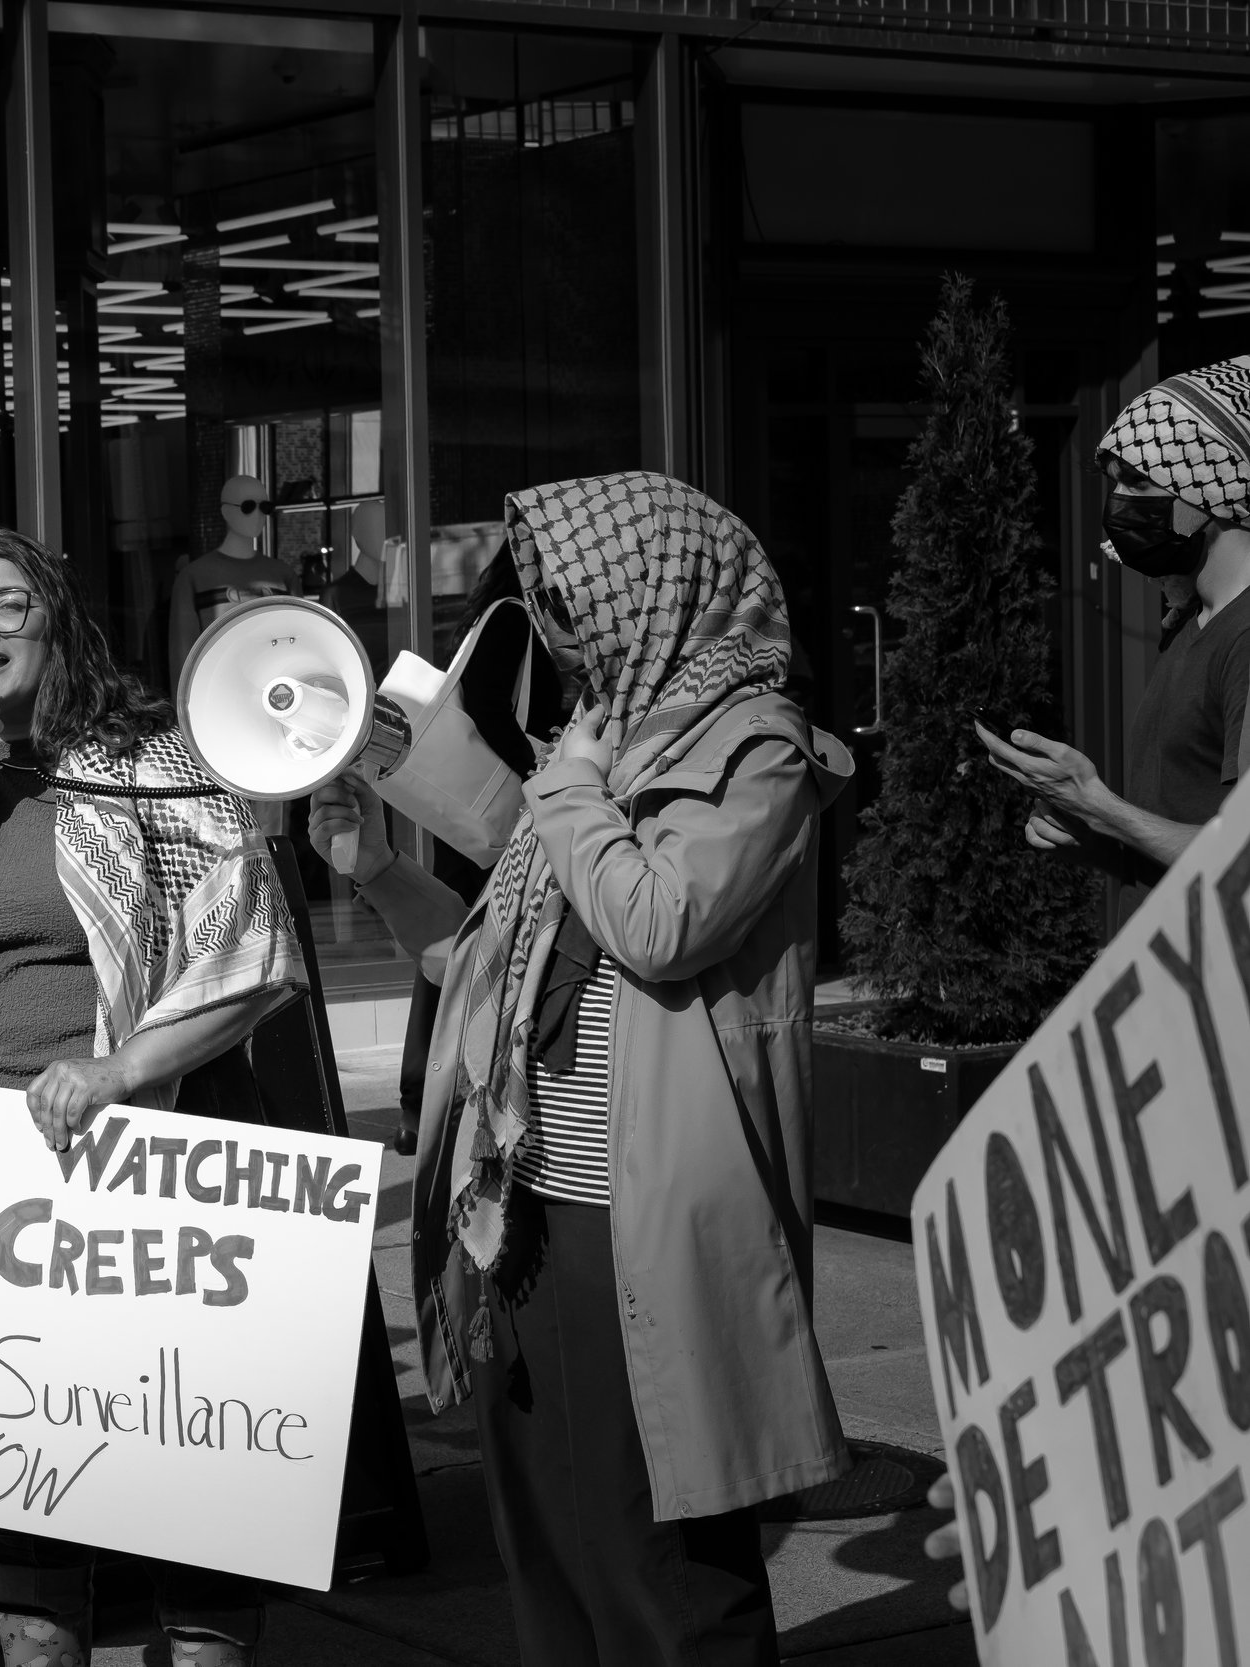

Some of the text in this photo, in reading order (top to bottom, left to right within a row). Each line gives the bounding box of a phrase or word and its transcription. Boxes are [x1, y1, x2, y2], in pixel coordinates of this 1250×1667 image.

[54, 1116, 370, 1223] WATCHING
[924, 871, 1249, 1419] MONEY
[956, 1217, 1250, 1634] DETRO
